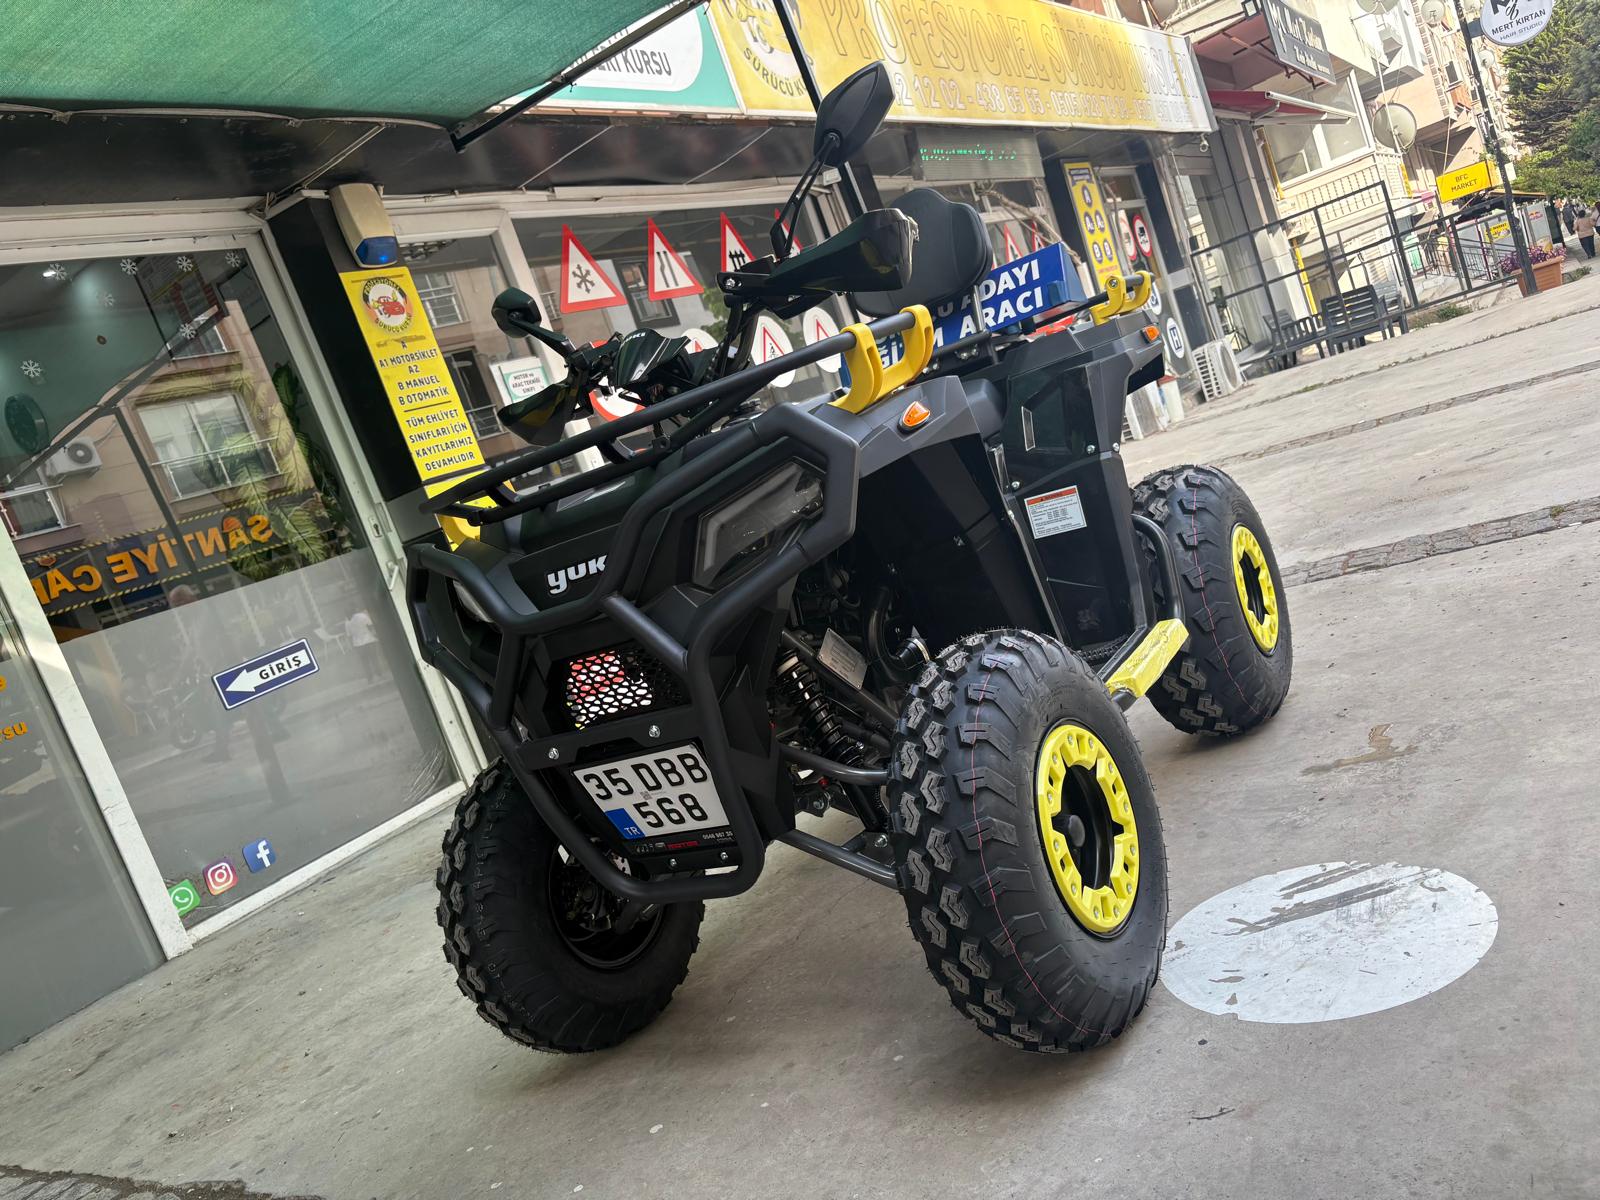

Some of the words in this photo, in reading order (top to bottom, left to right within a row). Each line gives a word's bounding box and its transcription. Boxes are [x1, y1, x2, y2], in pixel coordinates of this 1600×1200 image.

[1491, 21, 1514, 36] MERT
[1515, 8, 1547, 26] KIRTAN
[621, 48, 673, 77] KURSU
[743, 47, 795, 97] SÜRÜCÜ
[1451, 178, 1478, 193] MARKET
[1455, 173, 1469, 183] BFC
[959, 286, 1043, 338] ARACI
[401, 340, 408, 350] A
[379, 358, 389, 368] A1
[389, 348, 439, 365] MOTORSİKLET
[408, 364, 420, 375] A2
[397, 381, 405, 391] B
[405, 375, 441, 389] MANUEL
[398, 396, 406, 406] B
[406, 386, 449, 404] OTOMATİK
[405, 416, 426, 429] TÜM
[425, 409, 460, 425] EHLİYET
[409, 426, 451, 444] SINIFLARI
[449, 422, 468, 434] İÇİN
[415, 436, 474, 459] KAYITLARIMIZ
[424, 451, 476, 472] DEVAMLIDIR
[258, 655, 302, 681] GİRİŞ
[583, 767, 635, 801] 35
[630, 752, 709, 793] DBB
[632, 792, 709, 829] 568
[623, 825, 641, 837] TR
